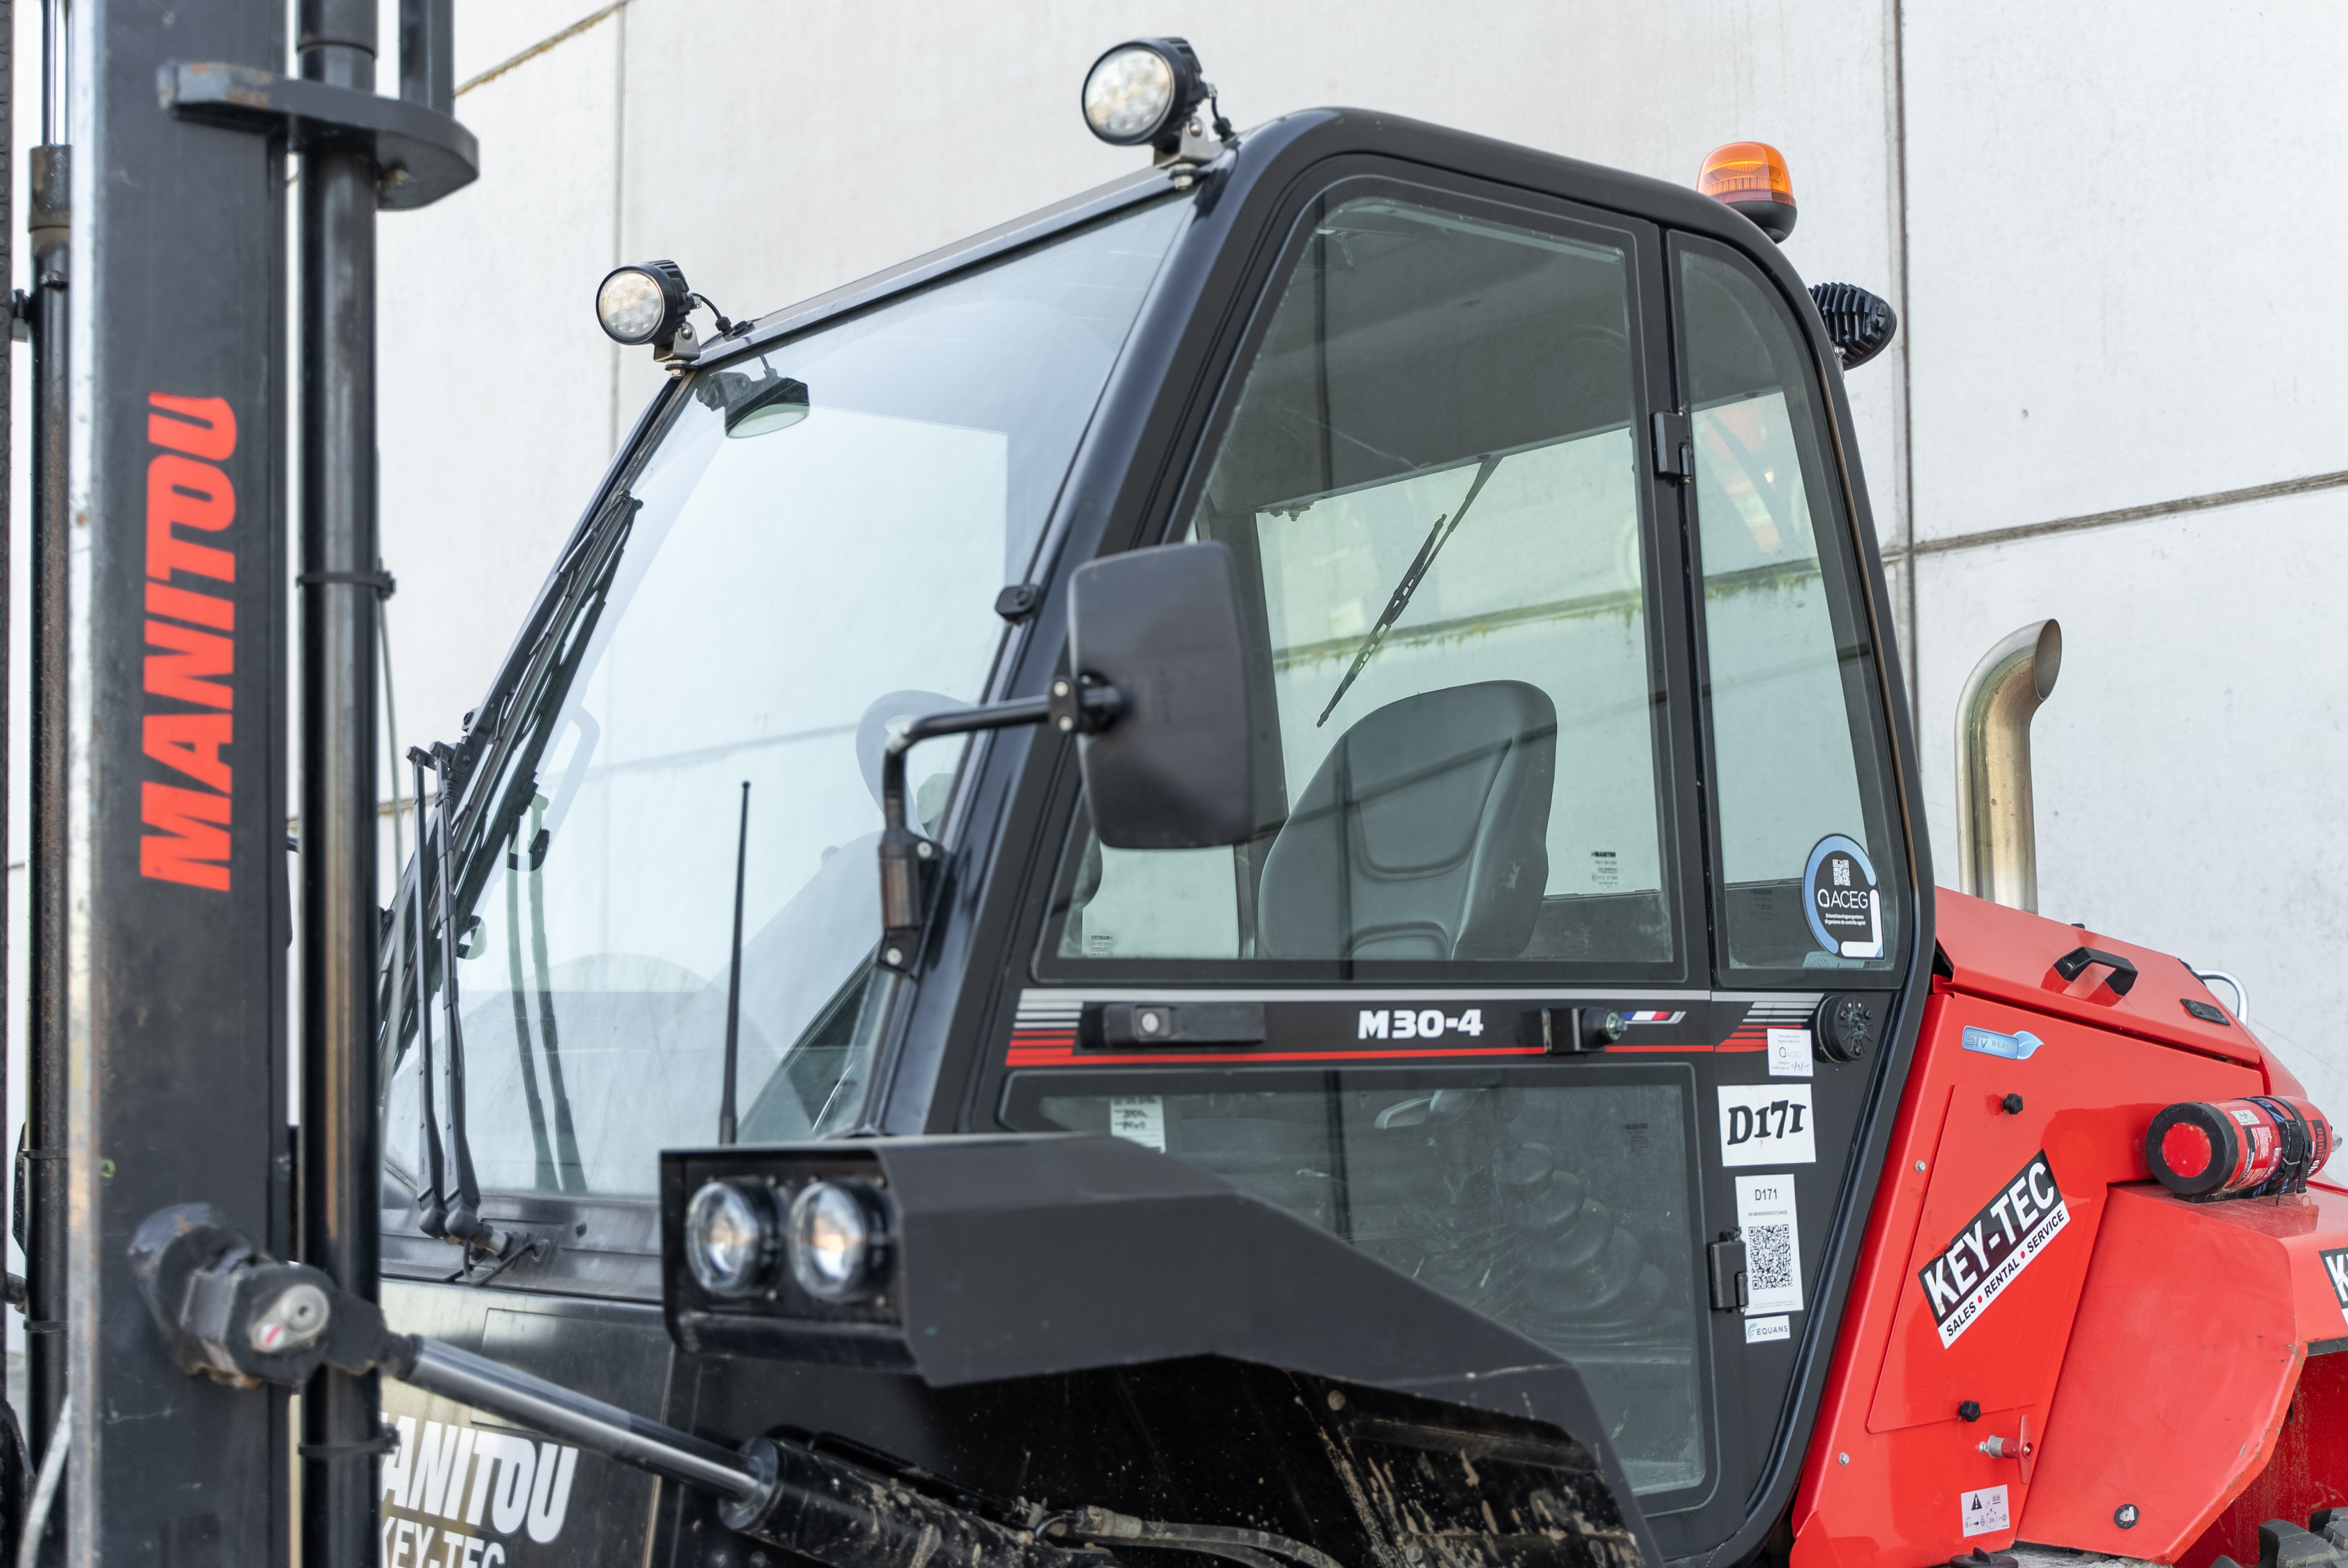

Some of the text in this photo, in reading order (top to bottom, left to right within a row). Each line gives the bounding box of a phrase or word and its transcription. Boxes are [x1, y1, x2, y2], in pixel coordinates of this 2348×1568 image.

[140, 391, 237, 892] MANITOU
[1357, 1008, 1484, 1040] M30-4
[1991, 1040, 2016, 1051] READY
[1727, 1099, 1807, 1146] D171
[1755, 1188, 1777, 1201] D171
[1924, 1162, 2054, 1317] KEY-TEC
[1946, 1210, 2064, 1337] SALES RENTAL SERVICE
[1757, 1325, 1788, 1335] EQUANS
[381, 1411, 579, 1543] ANITOU
